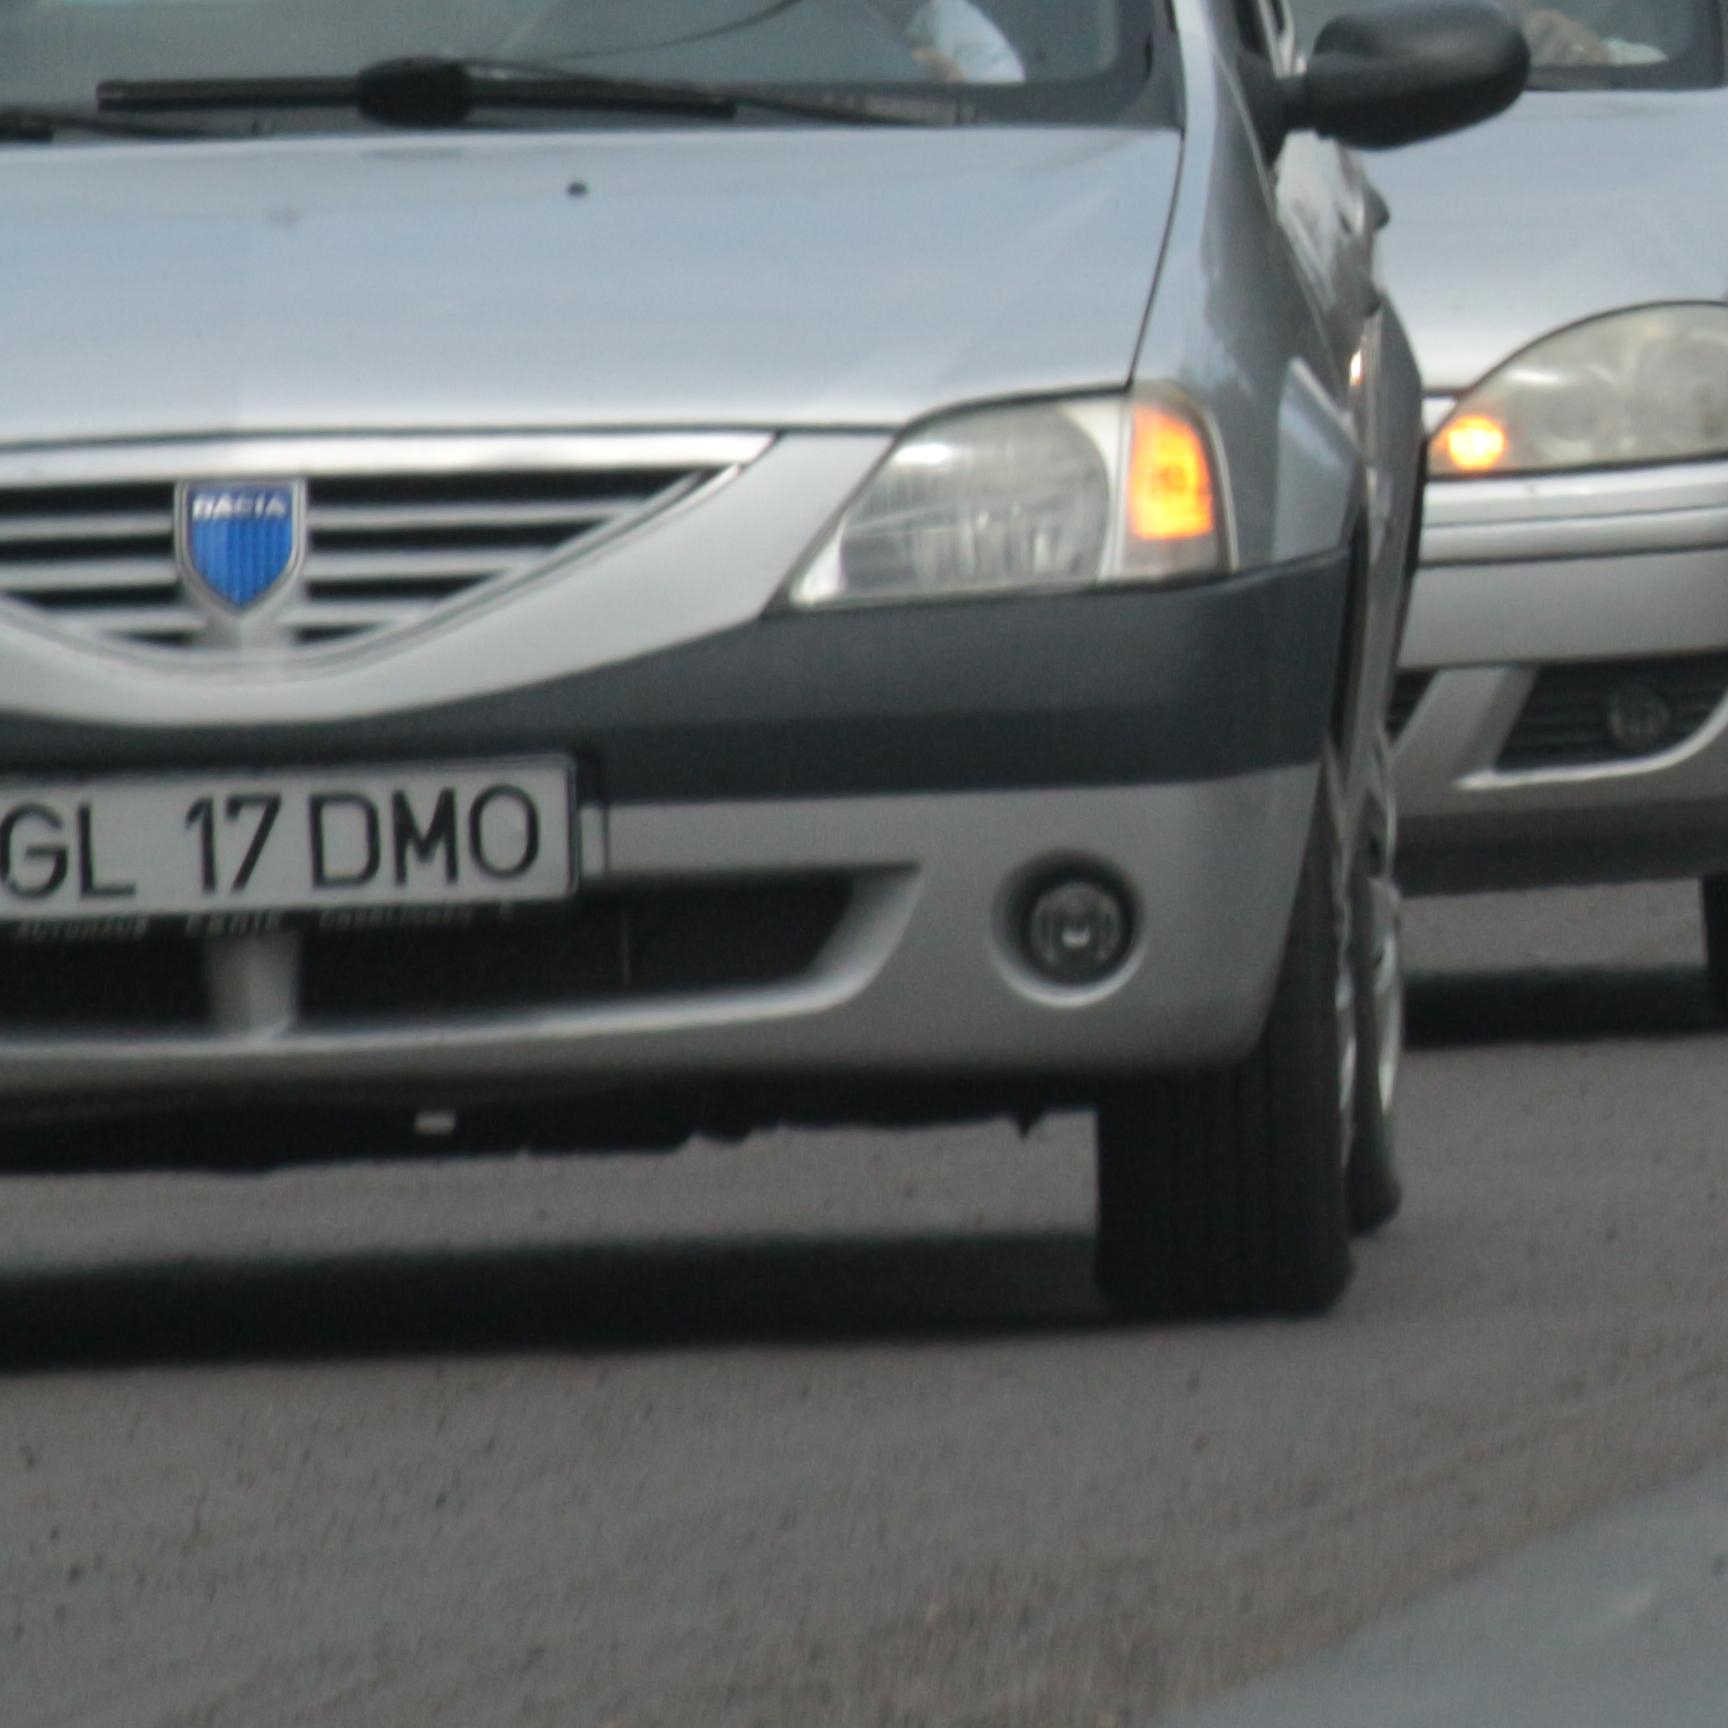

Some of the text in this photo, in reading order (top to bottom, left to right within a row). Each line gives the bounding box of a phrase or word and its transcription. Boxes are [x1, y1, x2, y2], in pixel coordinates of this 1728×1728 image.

[192, 493, 287, 521] DACIA
[0, 782, 540, 901] GL 17 DMO
